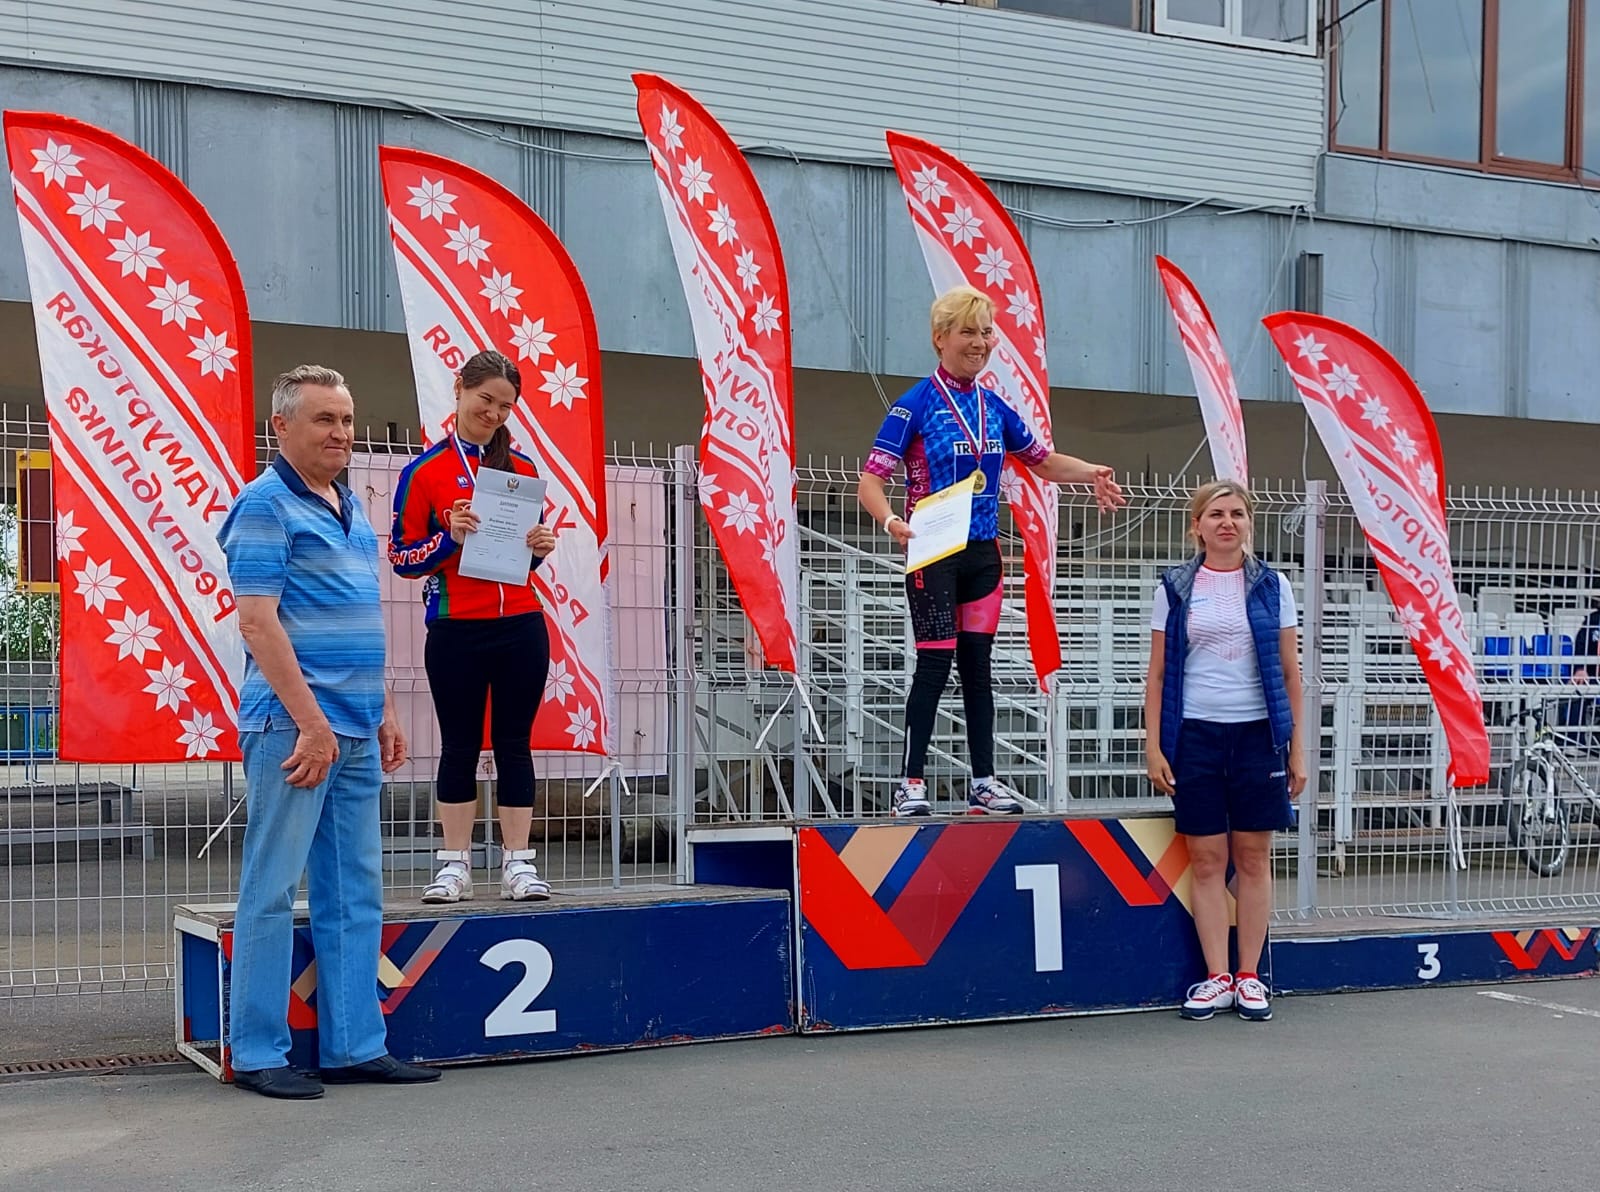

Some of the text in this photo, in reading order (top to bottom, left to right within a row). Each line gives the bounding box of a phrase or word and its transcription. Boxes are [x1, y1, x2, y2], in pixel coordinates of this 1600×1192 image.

[1015, 864, 1063, 972] 1
[1417, 943, 1441, 980] 3
[479, 939, 557, 1038] 2
